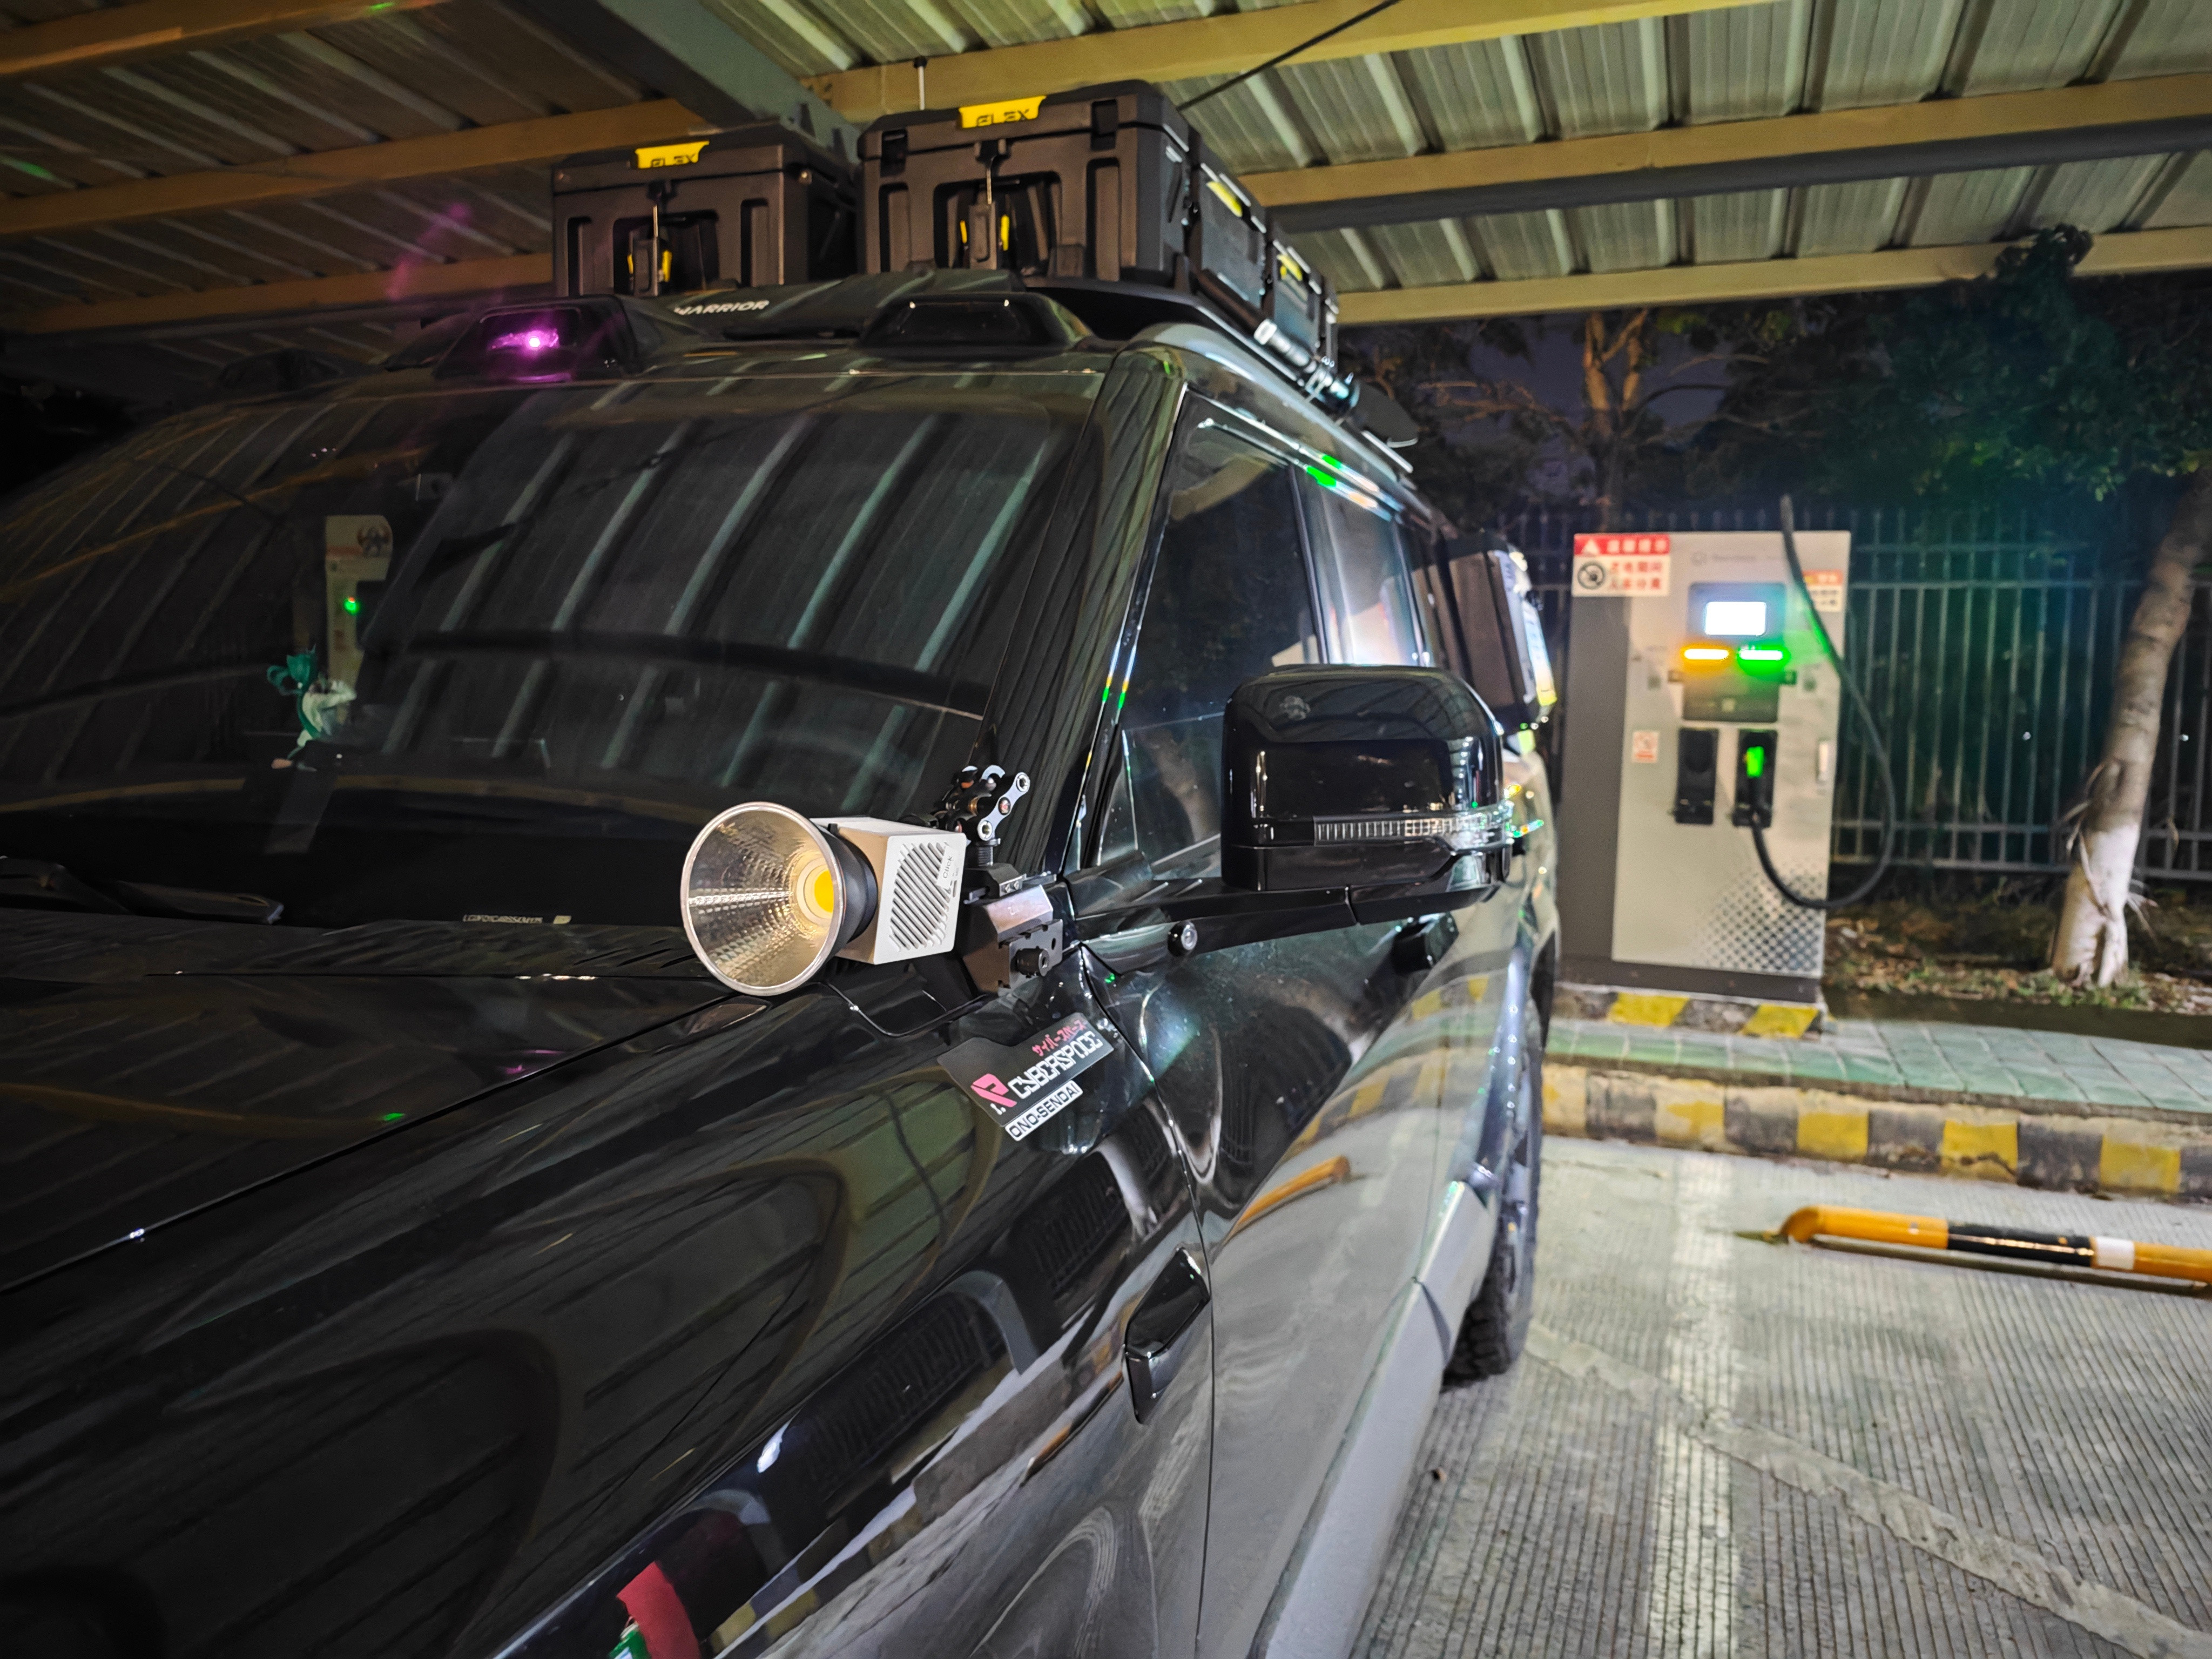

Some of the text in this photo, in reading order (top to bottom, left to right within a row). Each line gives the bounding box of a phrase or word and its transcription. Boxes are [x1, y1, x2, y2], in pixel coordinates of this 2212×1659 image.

[673, 300, 770, 316] WARRIOR
[1007, 1030, 1103, 1099] CYBERSPACE
[1009, 1082, 1080, 1138] ONO-SENDAI
